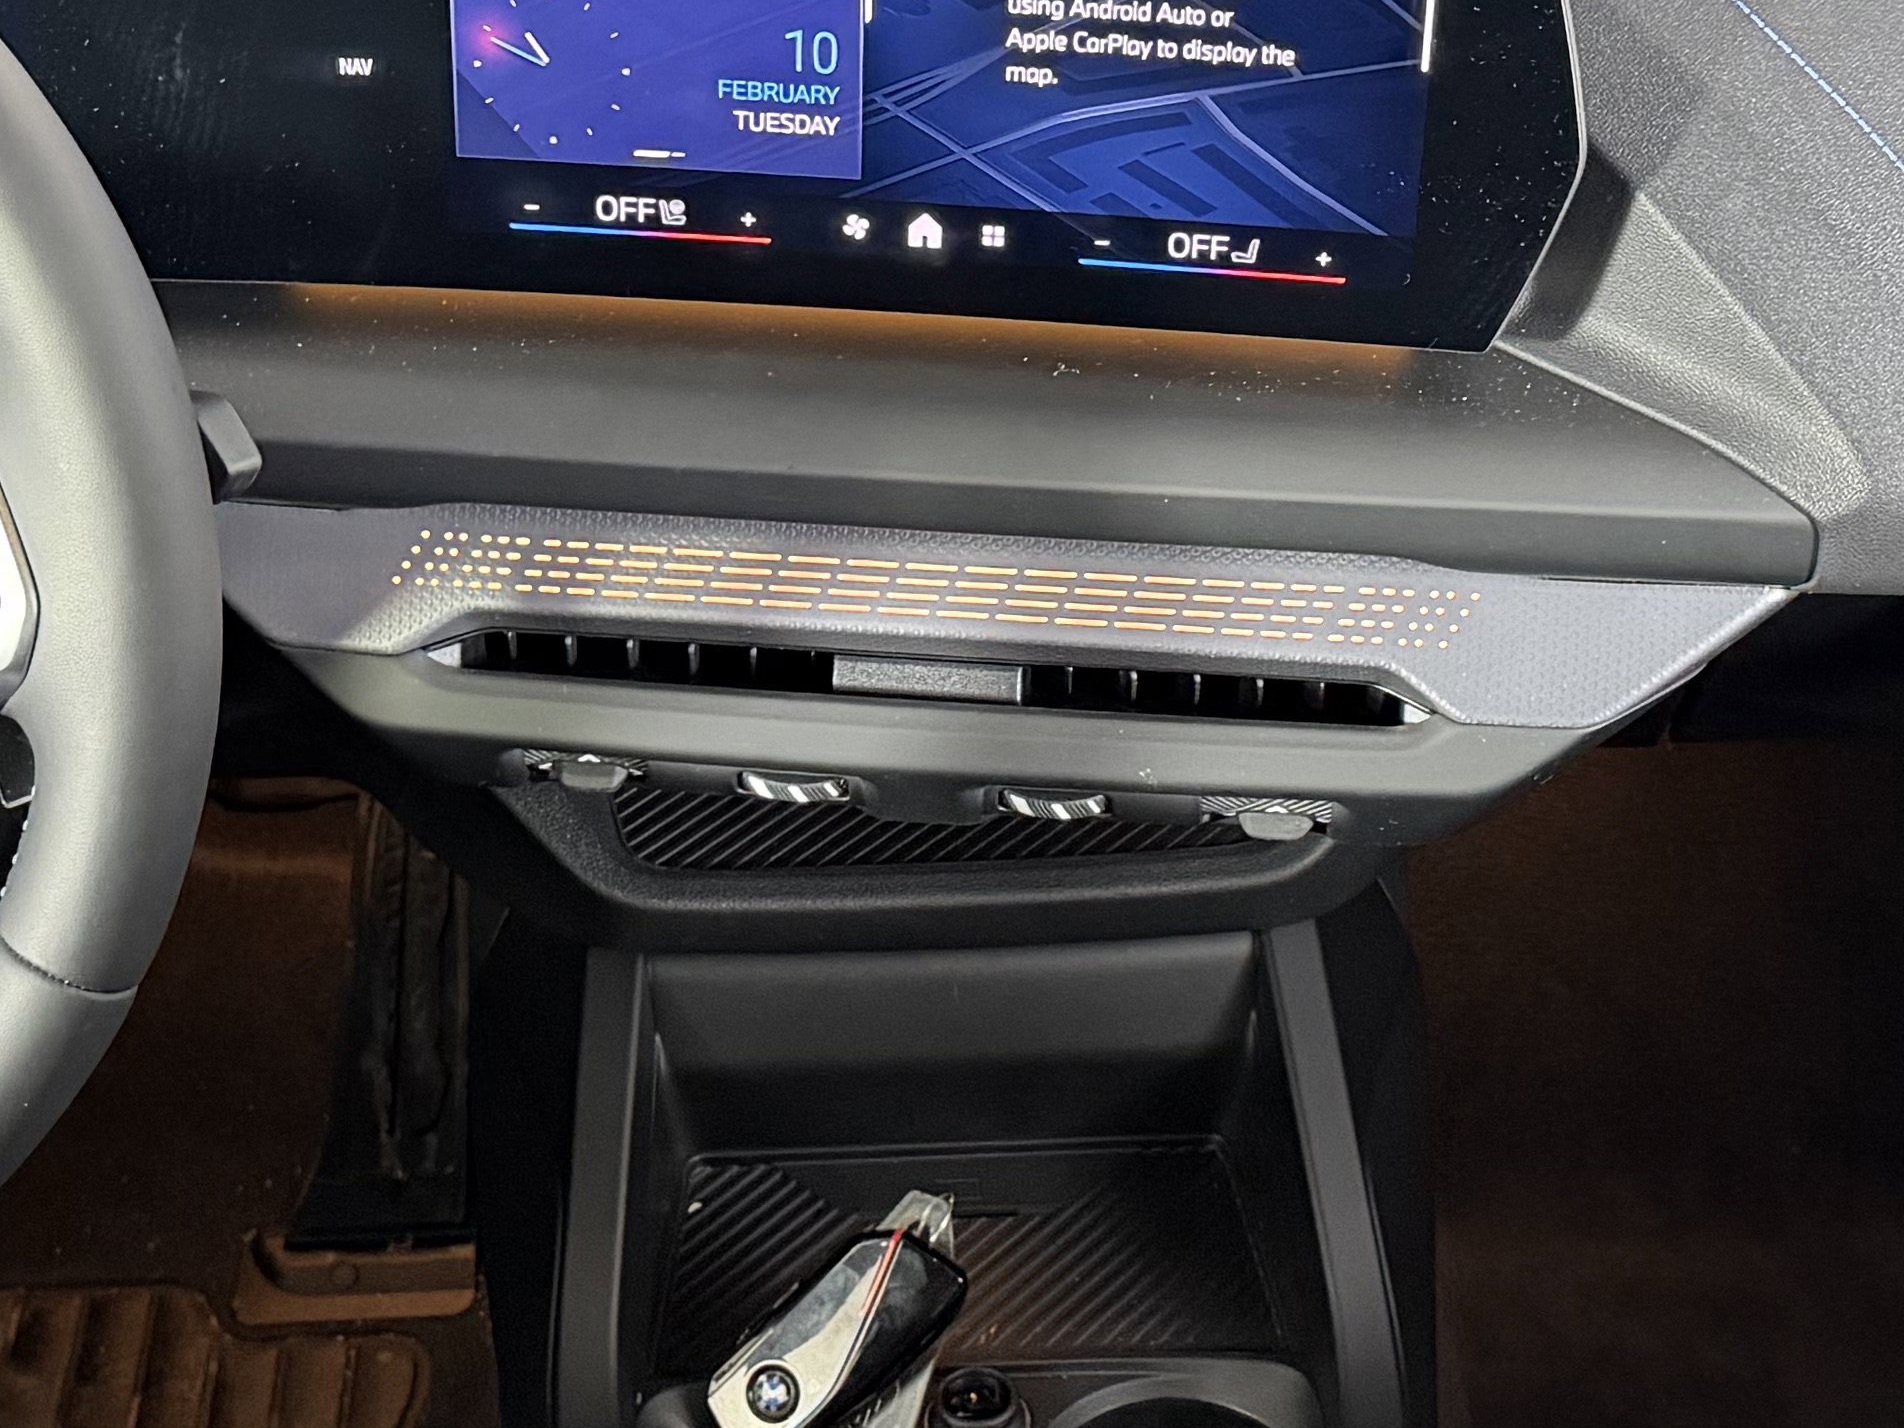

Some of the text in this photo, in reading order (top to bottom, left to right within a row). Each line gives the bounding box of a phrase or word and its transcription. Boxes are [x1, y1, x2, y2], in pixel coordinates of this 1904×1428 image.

[1155, 1, 1206, 26] Auto
[1210, 8, 1234, 28] or
[784, 28, 839, 76] 10
[1005, 28, 1296, 67] Apple CarPlay to display the
[338, 57, 374, 77] NAV
[1004, 64, 1058, 88] map.
[717, 78, 841, 106] FEBRUARY
[732, 109, 841, 136] TUESDAY
[595, 195, 656, 223] OFF
[1167, 231, 1230, 259] OFF
